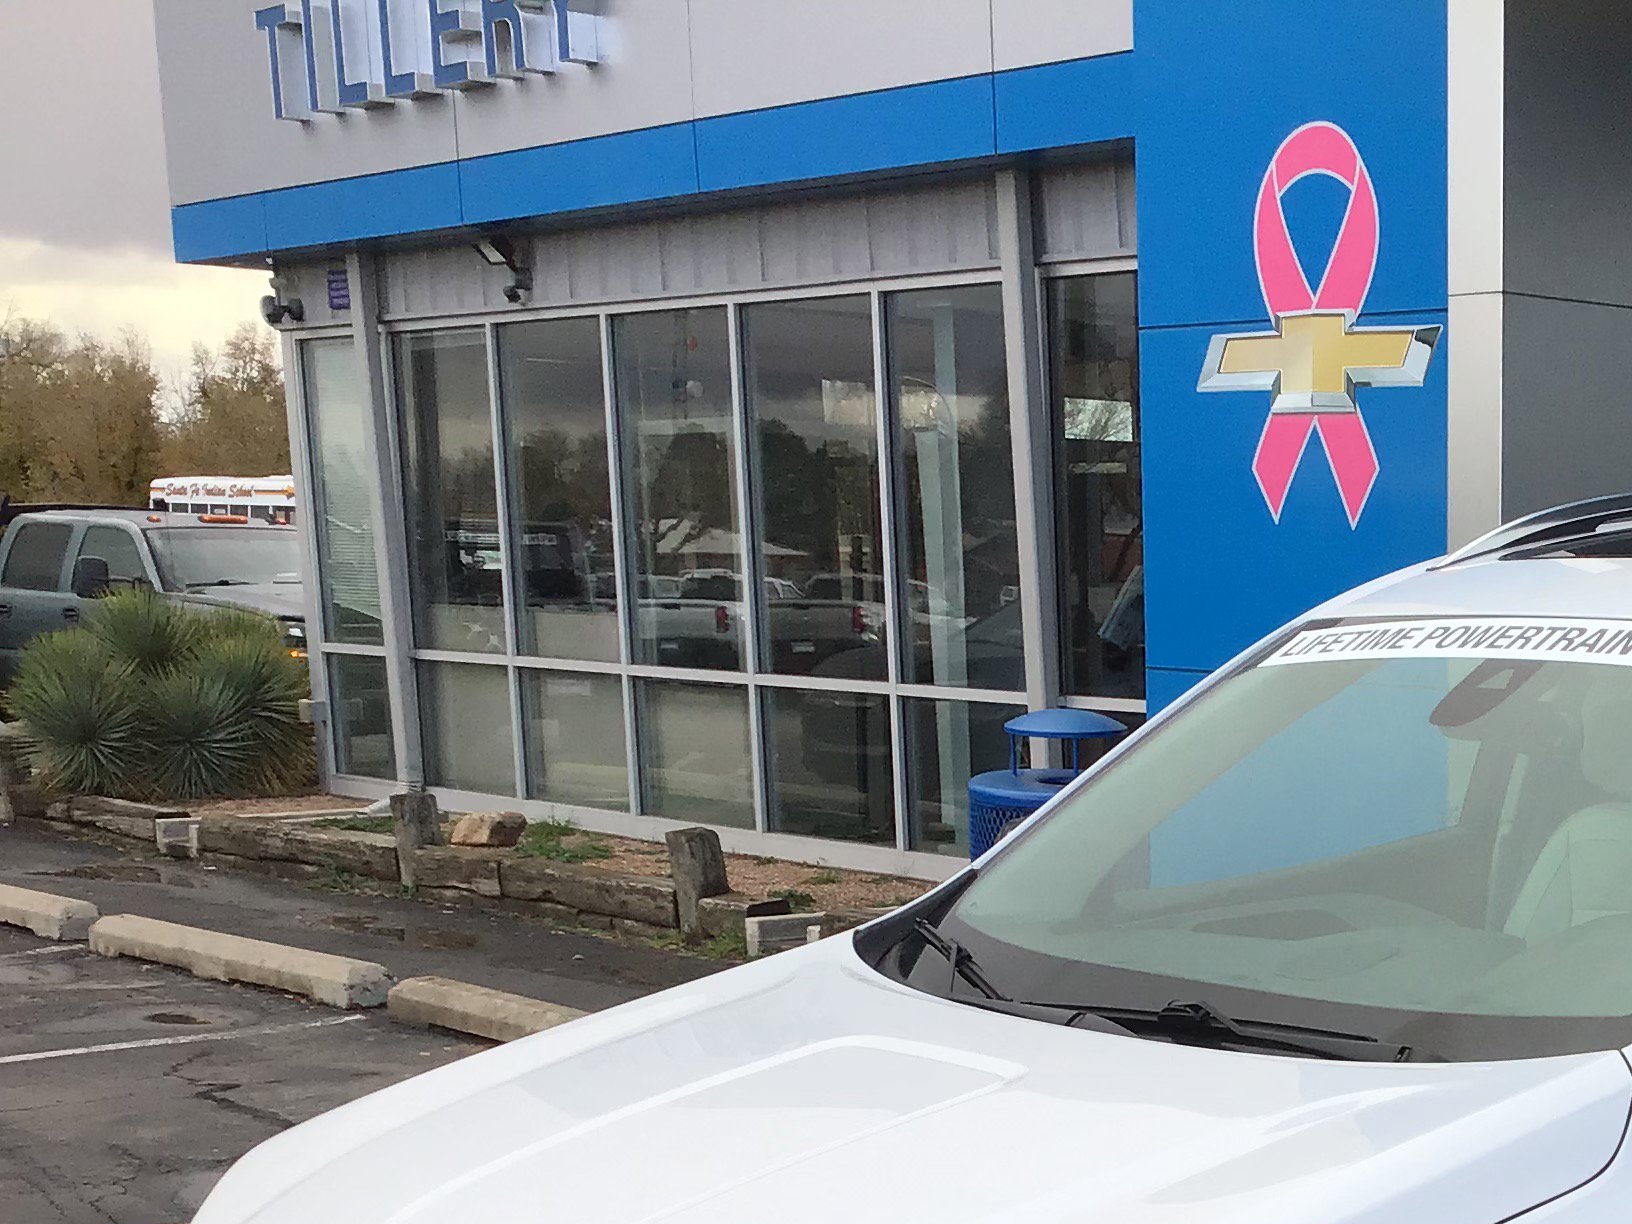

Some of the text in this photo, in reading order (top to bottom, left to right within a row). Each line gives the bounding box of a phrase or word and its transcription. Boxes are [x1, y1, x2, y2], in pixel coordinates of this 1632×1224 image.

[166, 483, 254, 499] Santa Fe Indian School
[1280, 627, 1423, 657] LIFETIME
